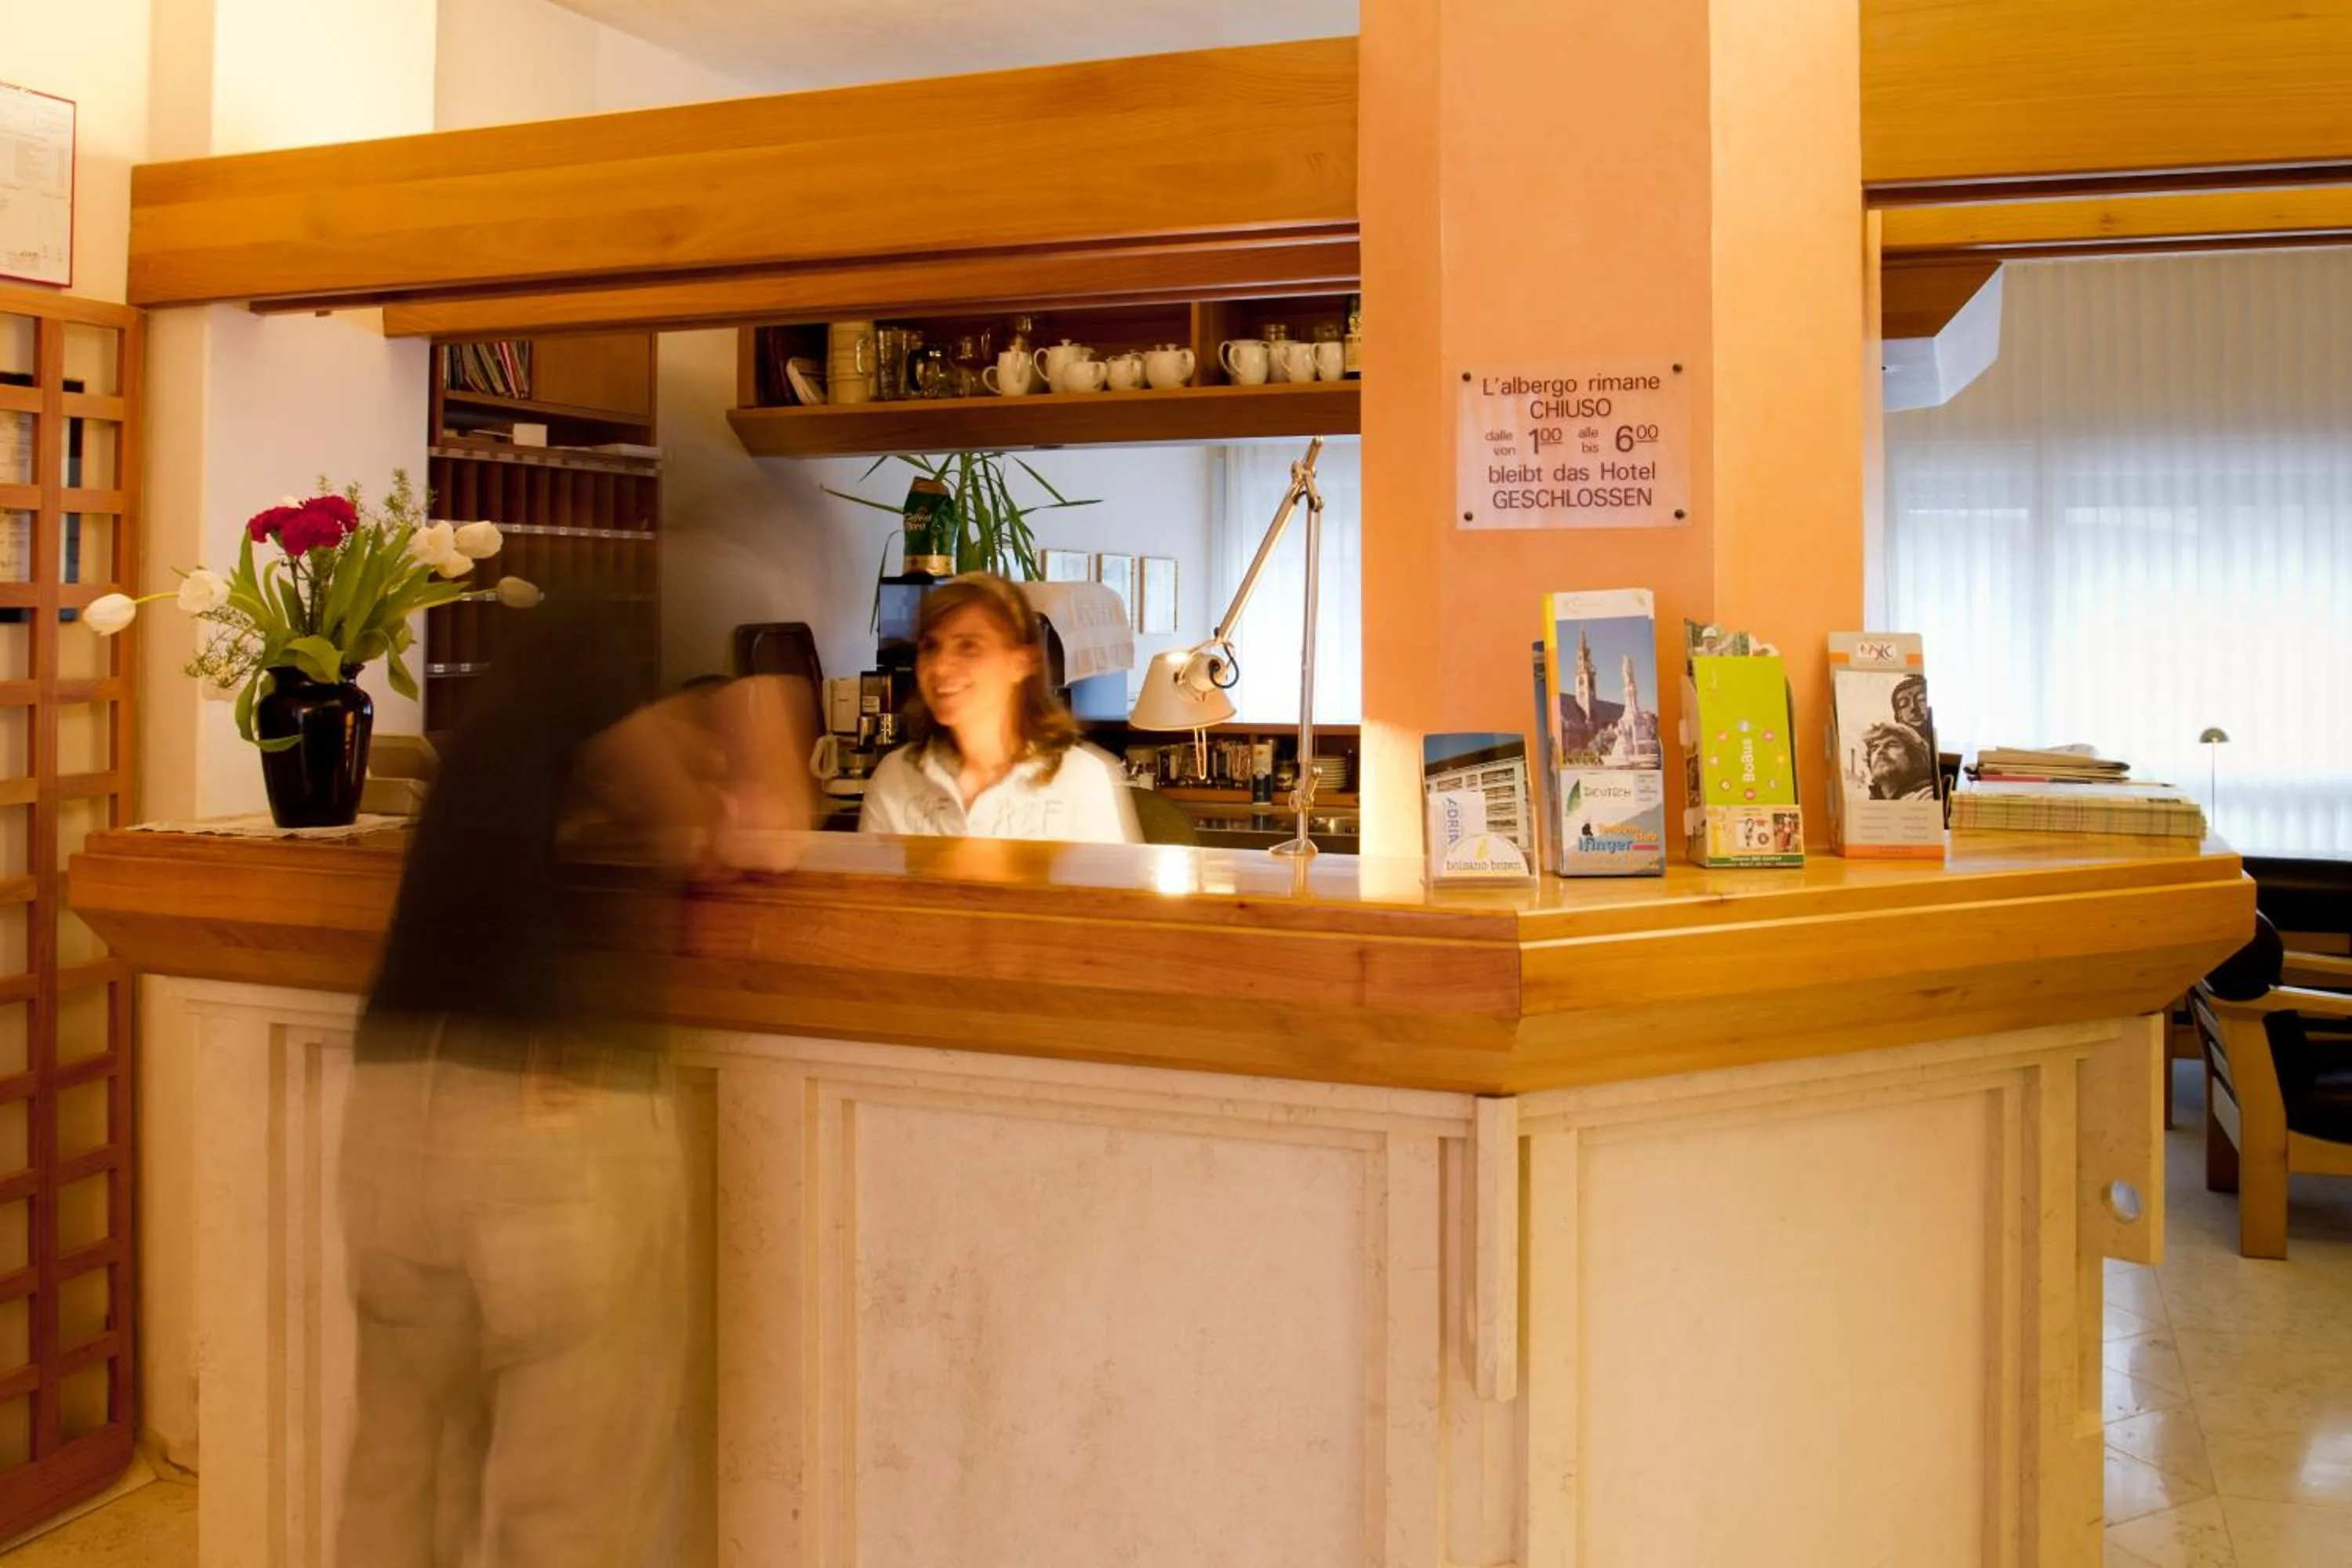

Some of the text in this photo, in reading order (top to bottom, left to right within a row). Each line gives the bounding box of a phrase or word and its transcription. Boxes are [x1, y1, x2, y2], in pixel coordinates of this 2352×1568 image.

[1483, 372, 1660, 397] L'albergo rimane
[1530, 397, 1611, 419] CHIUSO
[1485, 430, 1512, 442] dalle
[1578, 427, 1599, 439] alle
[1494, 441, 1599, 456] von bis
[1488, 461, 1656, 484] bleibt das Hotel
[1492, 488, 1652, 510] GESCHLOSSEN
